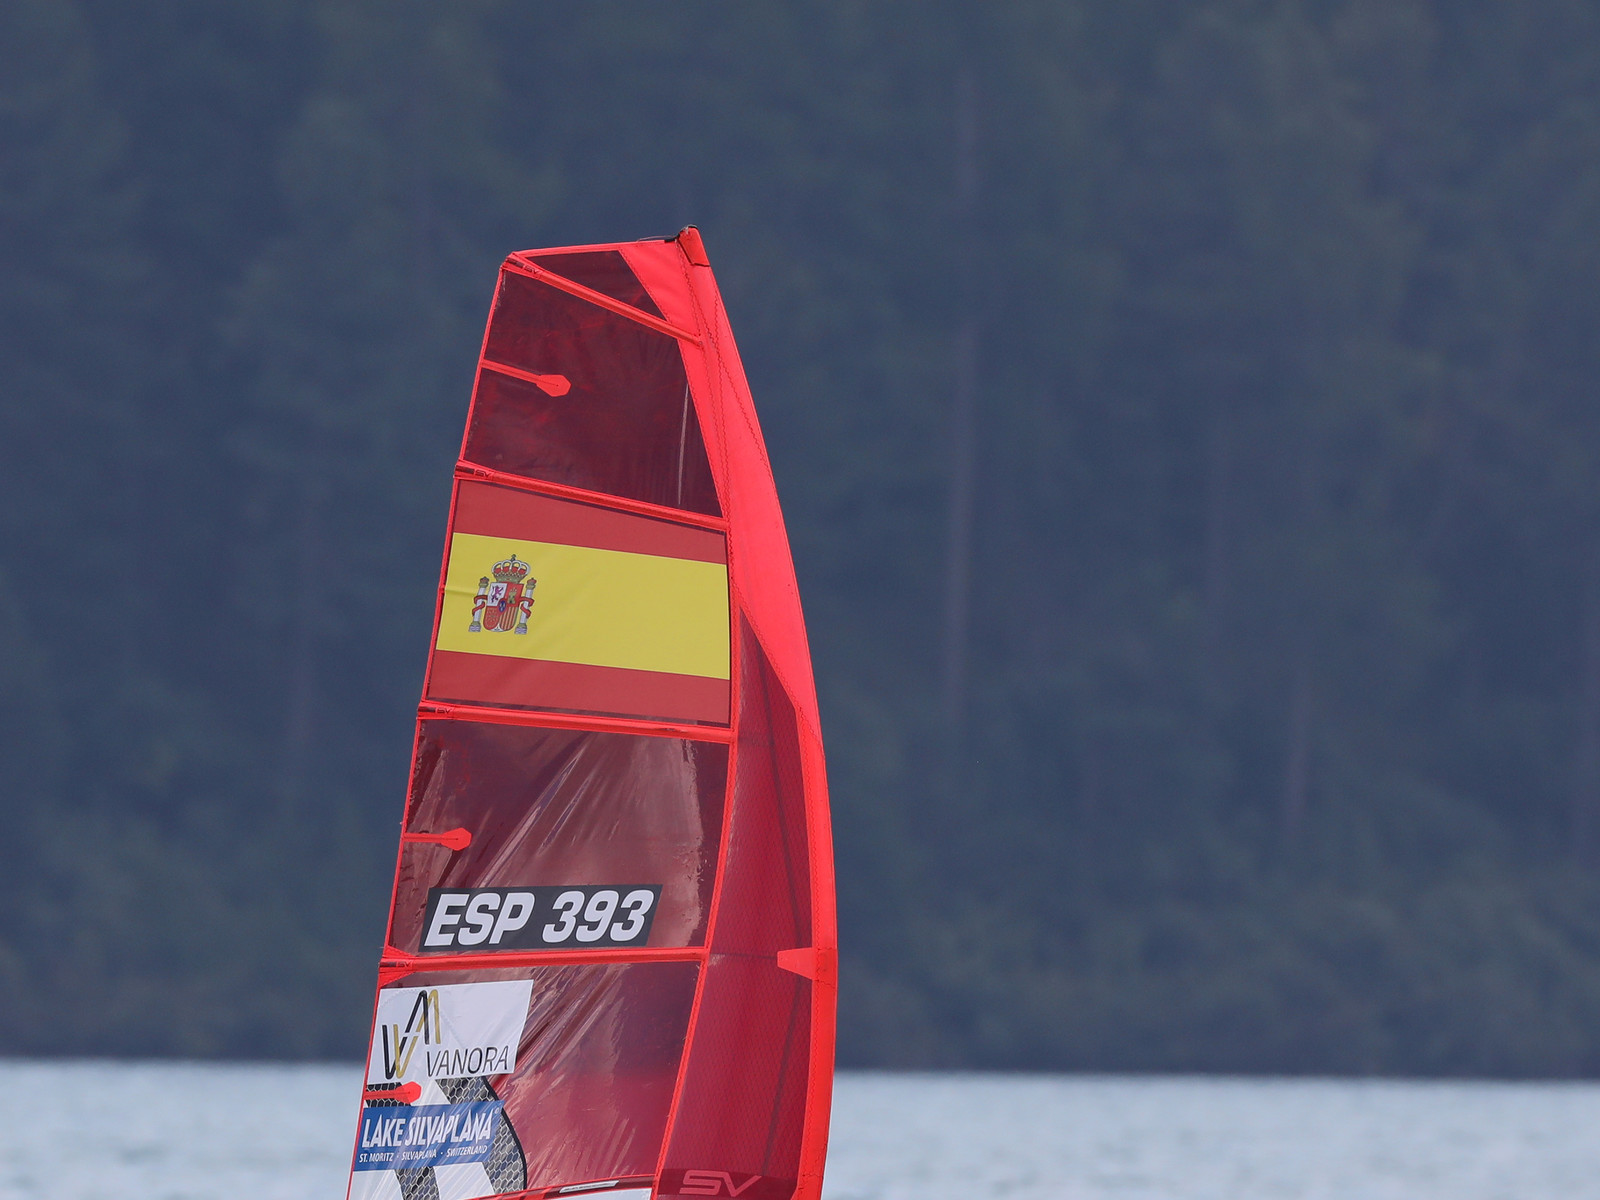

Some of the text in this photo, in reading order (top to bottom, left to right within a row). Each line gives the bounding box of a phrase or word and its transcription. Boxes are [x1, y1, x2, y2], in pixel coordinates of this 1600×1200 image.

[424, 890, 654, 946] ESP 393
[426, 1046, 509, 1077] VANORA
[362, 1108, 494, 1148] LAKE SILVAPLANA
[359, 1147, 488, 1163] ST. MORITZ SILVAPLANA SWITZERLAND
